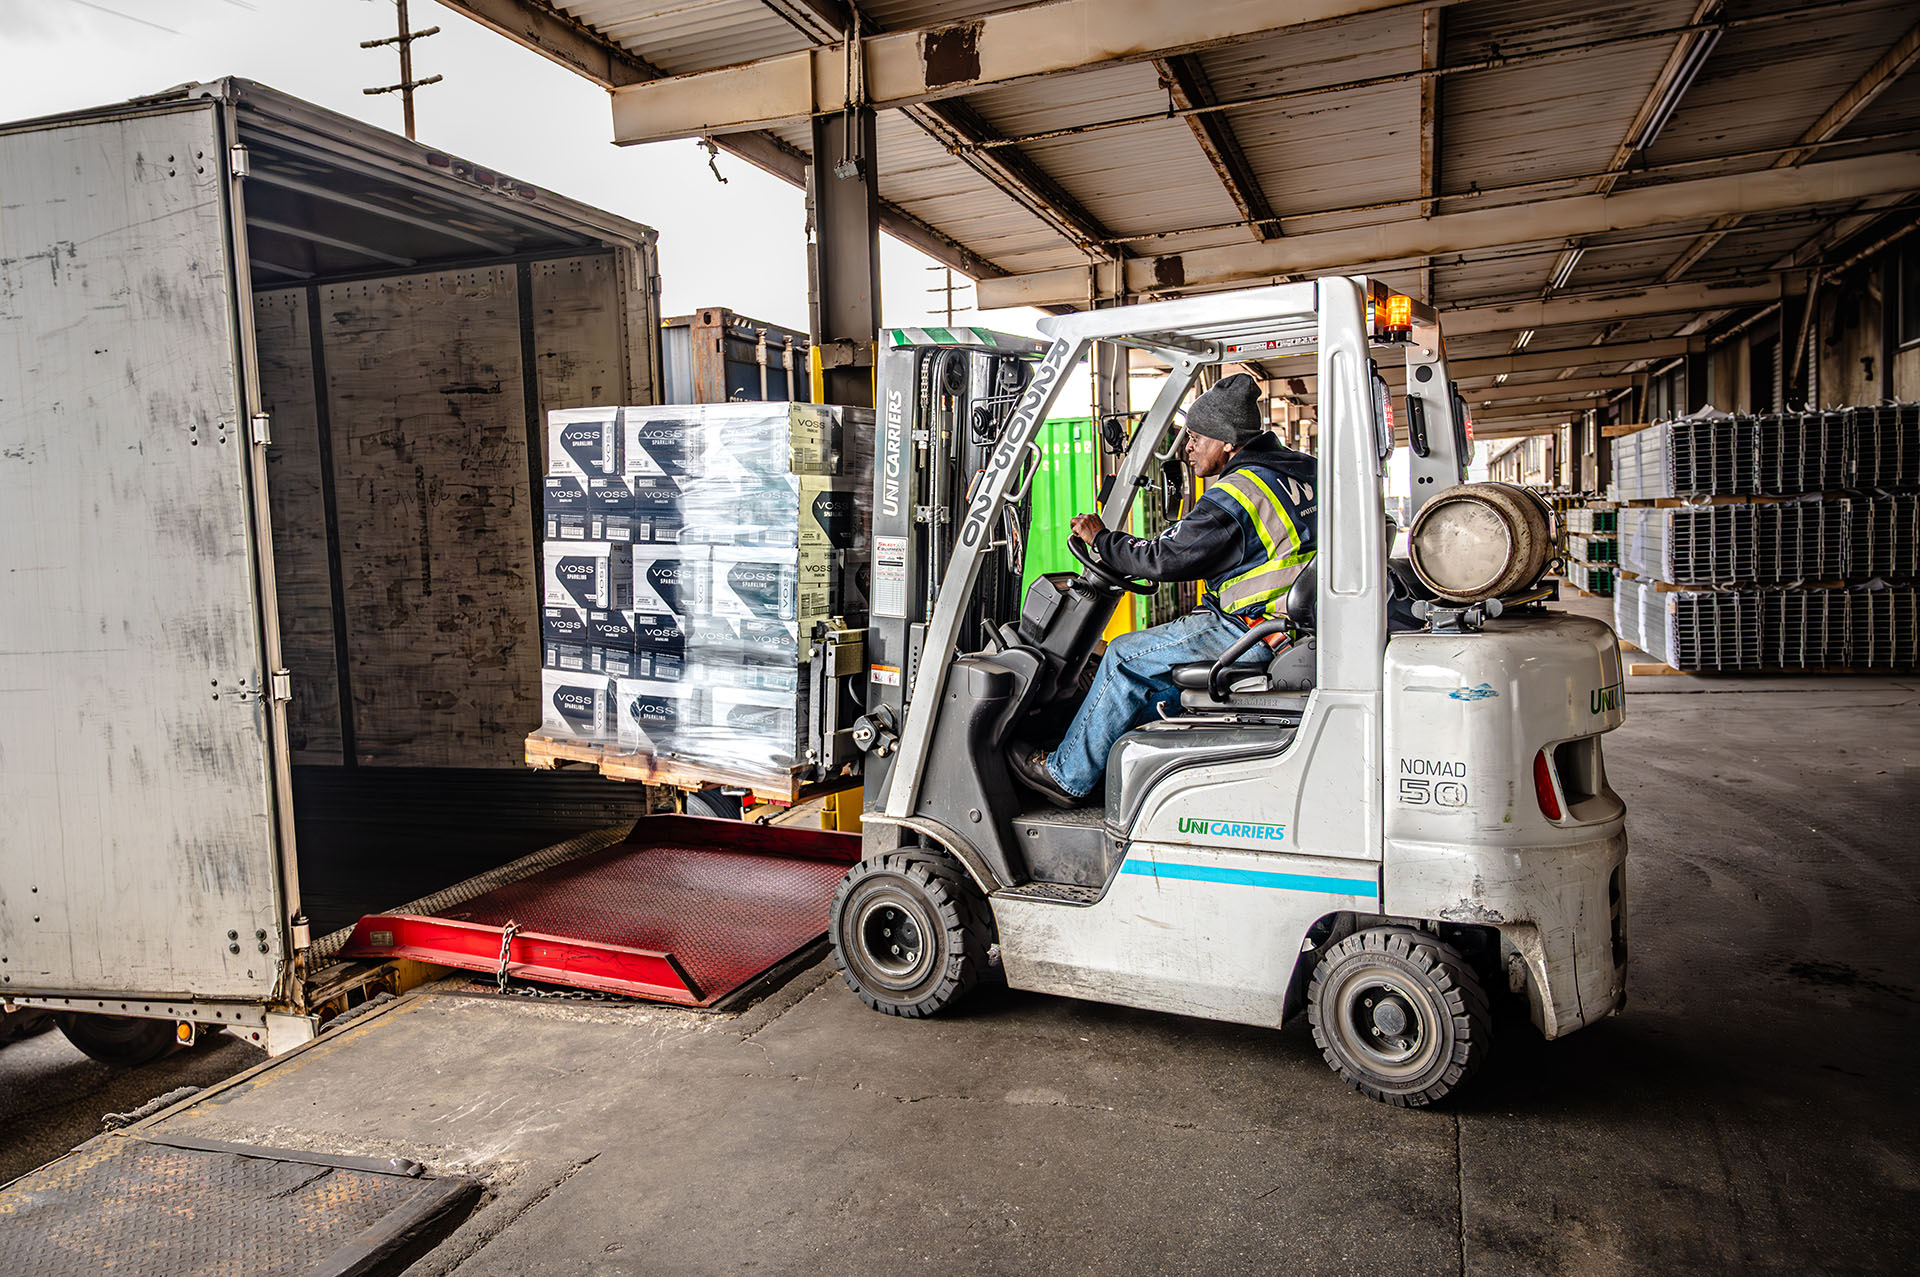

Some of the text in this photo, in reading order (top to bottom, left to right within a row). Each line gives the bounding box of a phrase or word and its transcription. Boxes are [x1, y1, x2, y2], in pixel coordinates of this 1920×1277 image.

[798, 418, 825, 430] VOSS
[565, 431, 600, 440] VOSS
[643, 429, 683, 438] VOSS
[963, 337, 1070, 547] R2205120
[882, 387, 902, 517] UNICARRIERS
[595, 491, 628, 499] VOSS
[644, 491, 678, 499] VOSS
[560, 564, 594, 574] VOSS
[652, 568, 692, 578] VOSS
[805, 564, 833, 573] VOSS
[733, 571, 777, 582] VOSS
[550, 620, 582, 629] VOSS
[595, 624, 628, 633] VOSS
[645, 628, 679, 637] VOSS
[752, 635, 790, 645] VOSS
[557, 693, 592, 705] VOSS
[636, 704, 675, 715] VOSS
[1400, 758, 1467, 778] NOMAD
[1400, 778, 1468, 807] 50
[1178, 817, 1286, 841] UNICARRIERS
